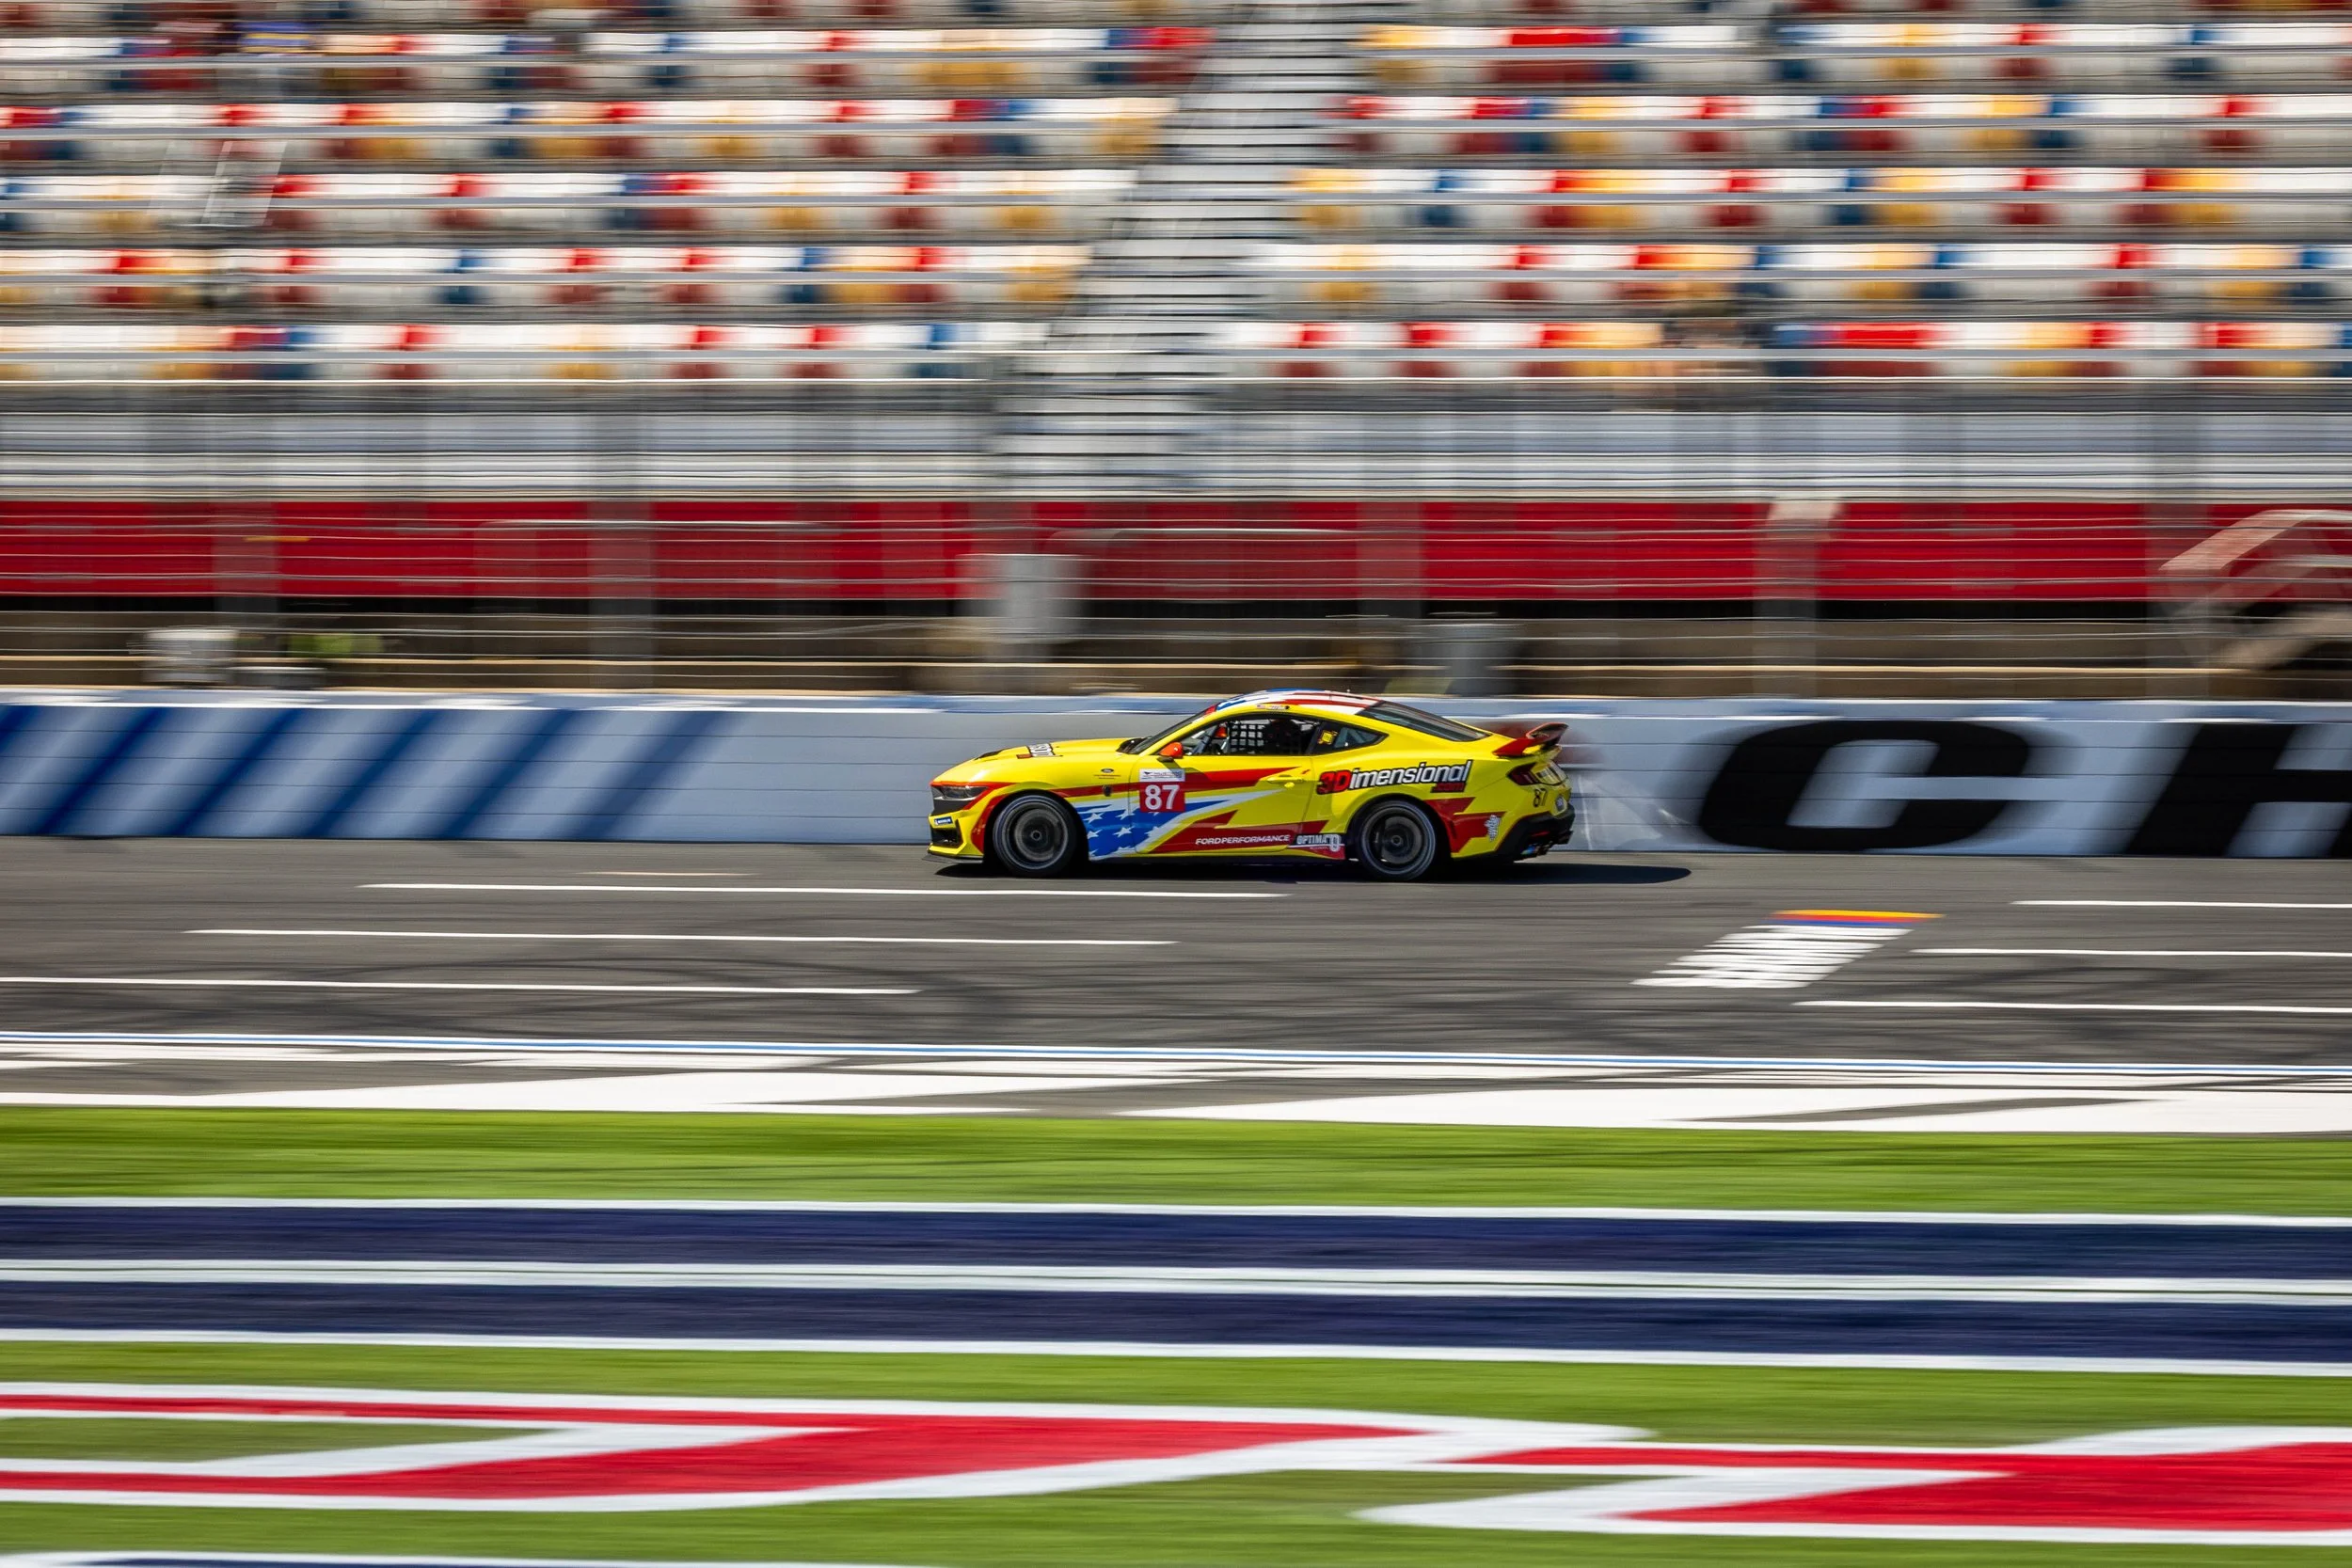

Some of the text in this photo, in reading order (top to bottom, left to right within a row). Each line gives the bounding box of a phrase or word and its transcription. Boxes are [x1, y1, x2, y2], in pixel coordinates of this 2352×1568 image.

[1317, 760, 1472, 794] 3Dimensional
[1145, 784, 1180, 811] 87
[1533, 787, 1548, 808] 87
[1296, 833, 1328, 845] OPTIMA
